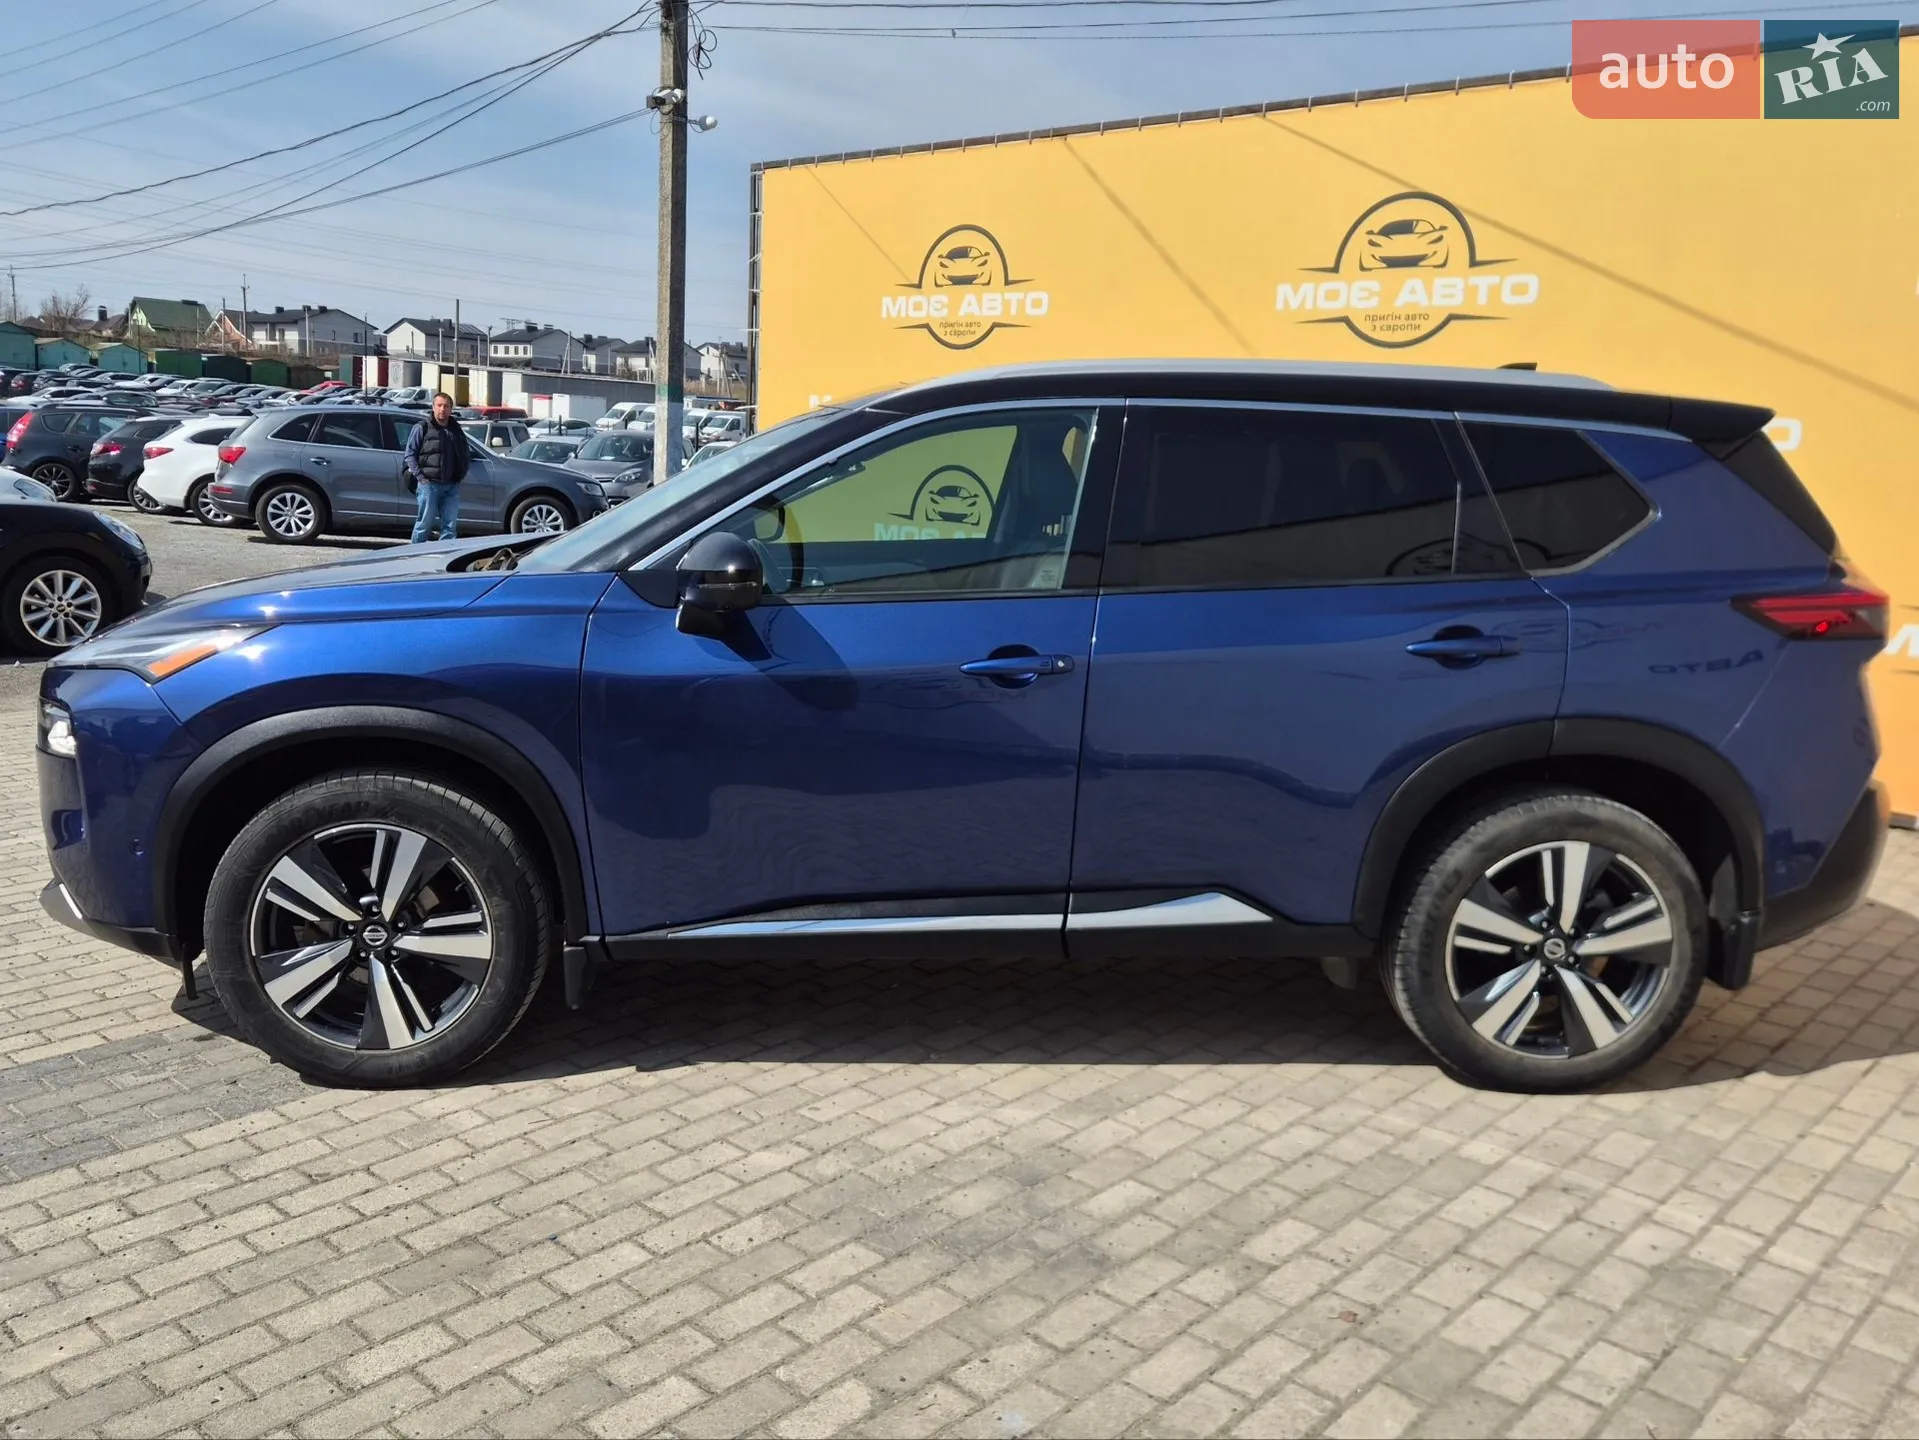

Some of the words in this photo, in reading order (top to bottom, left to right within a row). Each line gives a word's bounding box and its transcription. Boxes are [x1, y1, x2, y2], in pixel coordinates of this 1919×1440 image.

[881, 294, 949, 319] МОЄ
[957, 291, 1050, 317] АВТО
[1275, 280, 1381, 311] МОЄ
[1394, 274, 1541, 308] АВТО
[1404, 313, 1430, 321] авто
